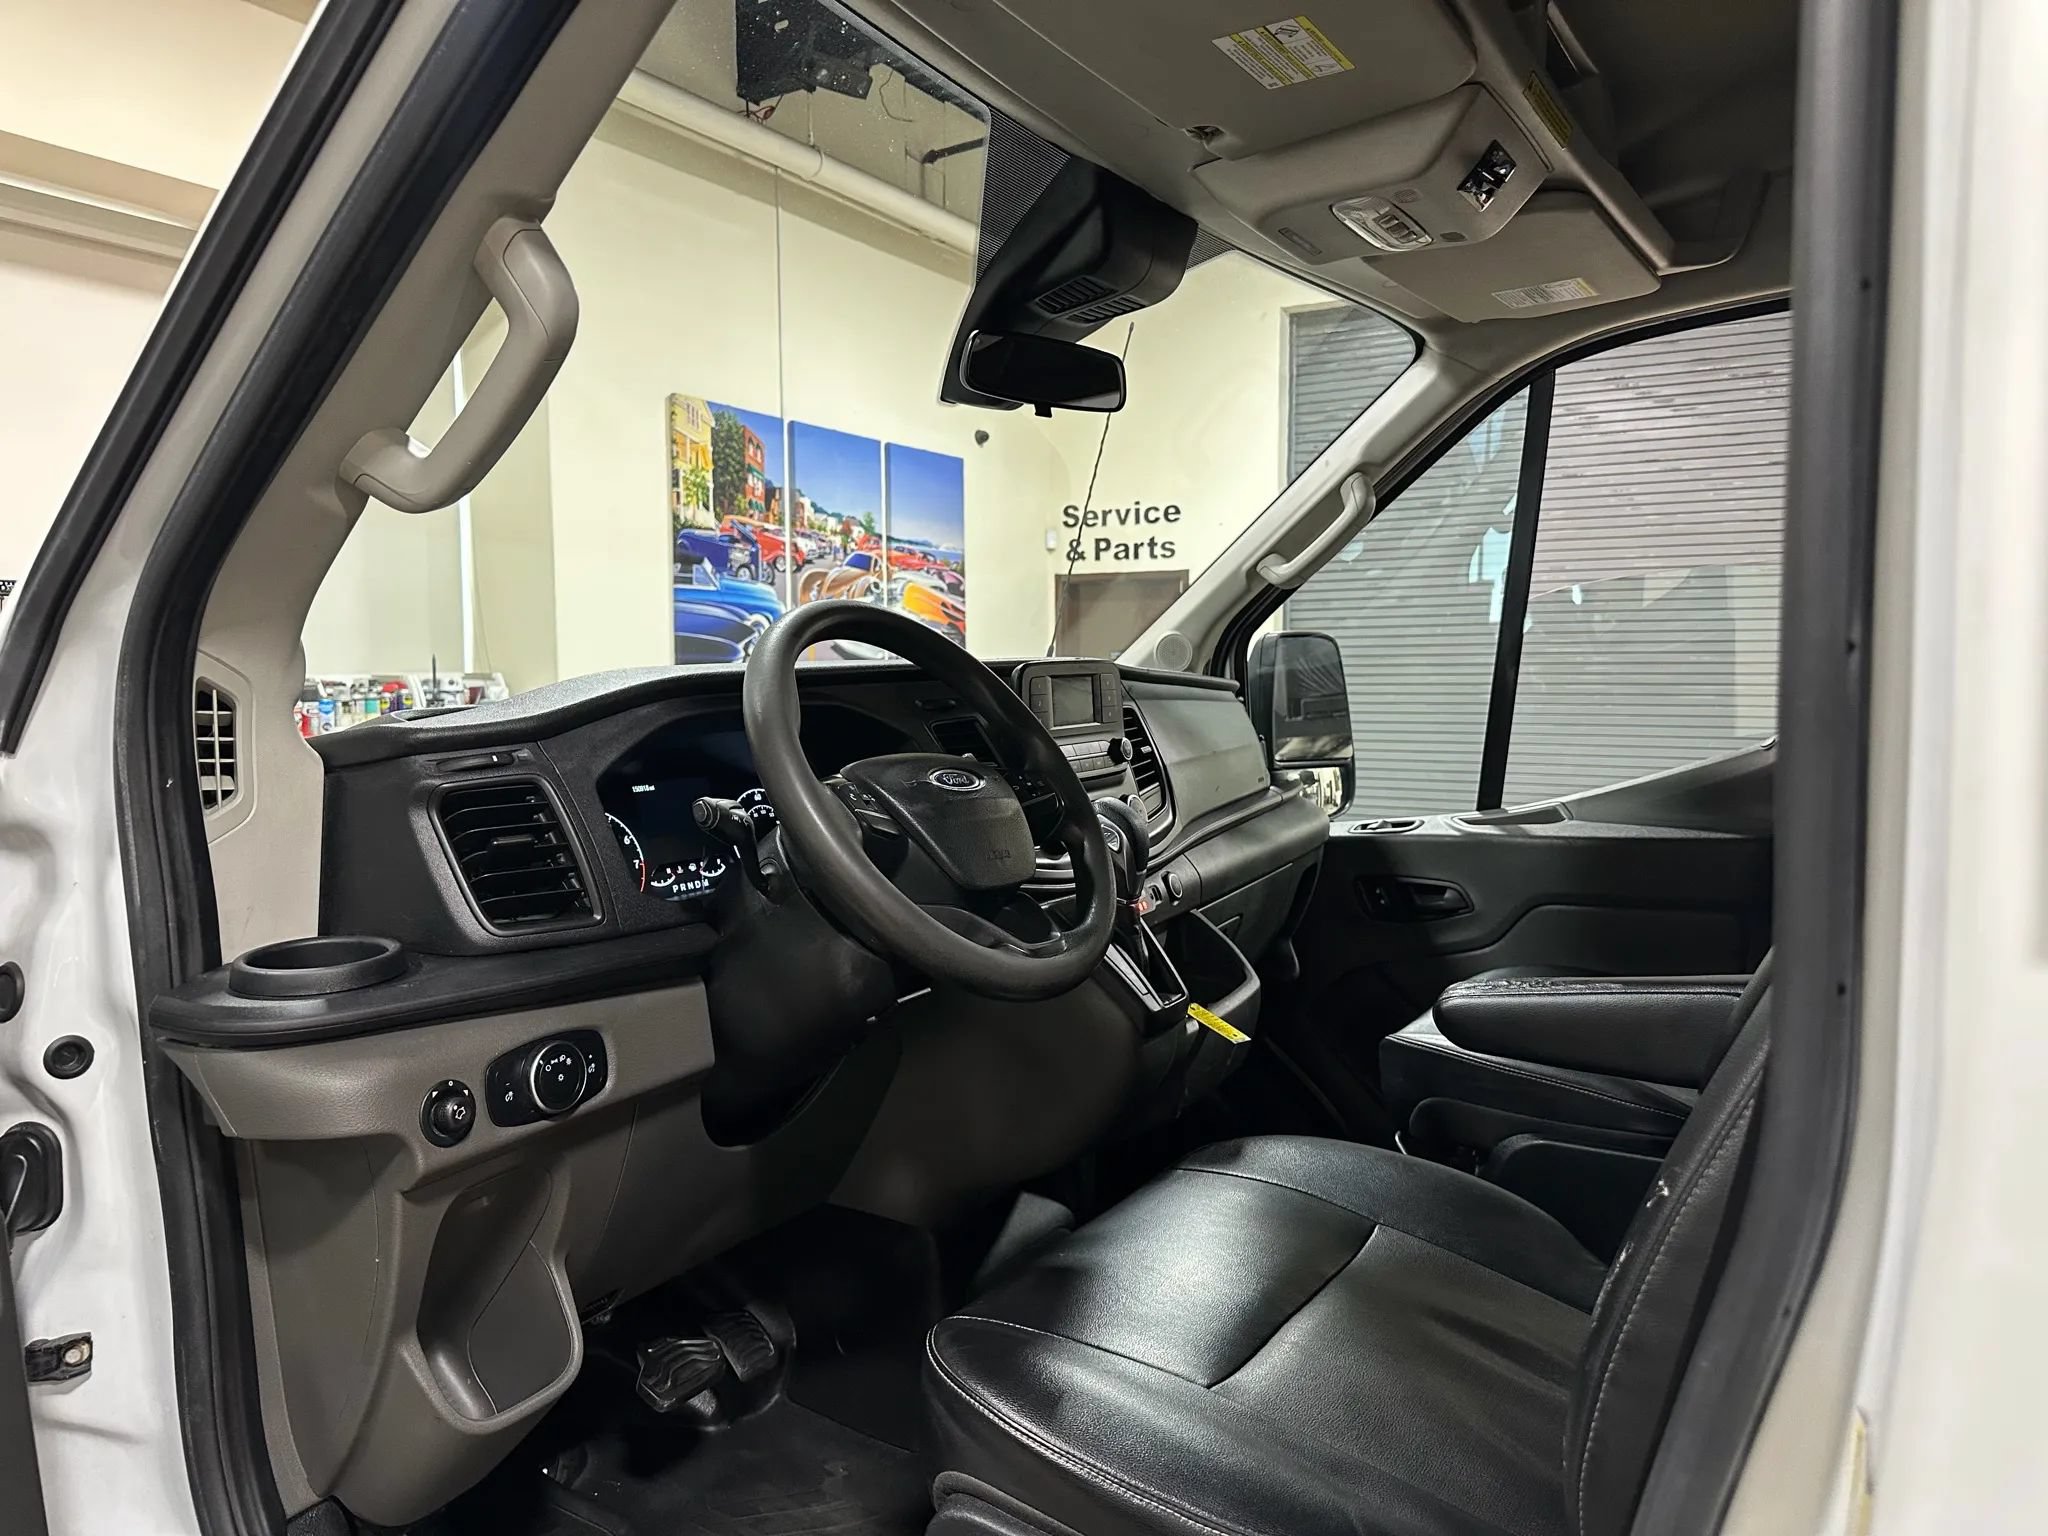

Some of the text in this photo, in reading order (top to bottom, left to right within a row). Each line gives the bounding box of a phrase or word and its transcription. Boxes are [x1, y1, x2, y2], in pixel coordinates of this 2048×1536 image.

[1062, 501, 1181, 528] Service
[1066, 536, 1176, 561] & Parts
[943, 773, 969, 785] Ford
[623, 835, 631, 845] 6
[633, 859, 640, 869] 7
